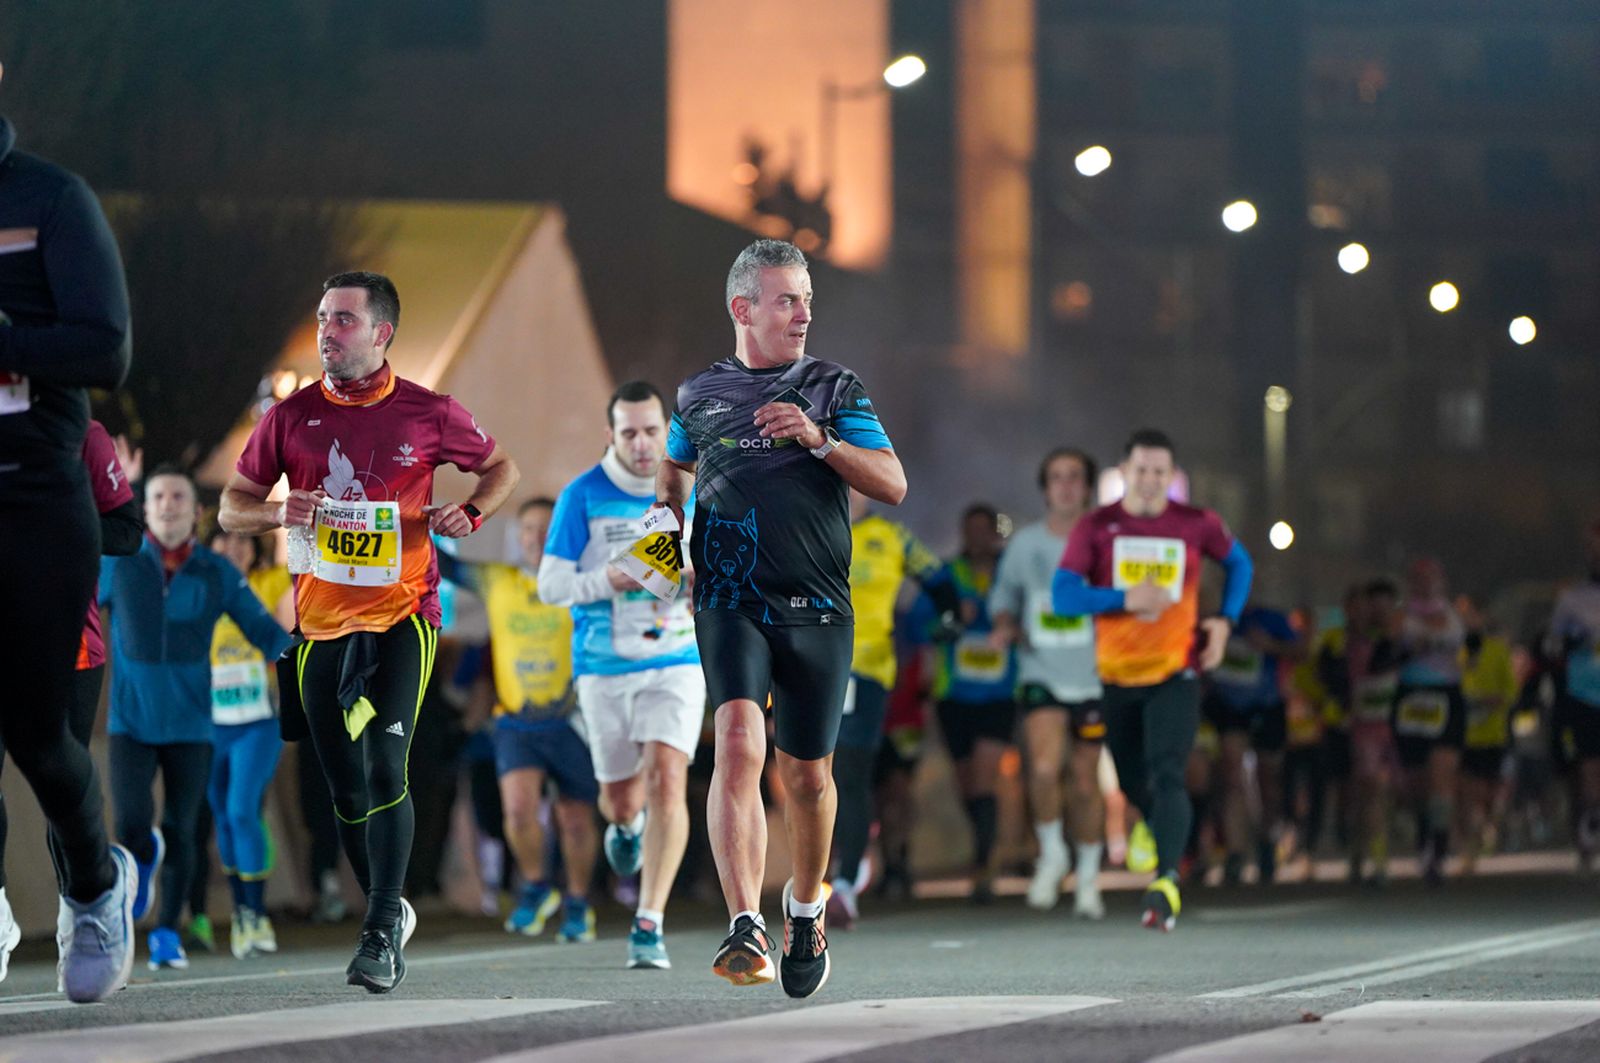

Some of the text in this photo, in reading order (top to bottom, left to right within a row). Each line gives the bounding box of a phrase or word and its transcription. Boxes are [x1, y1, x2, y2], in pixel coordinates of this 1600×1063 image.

[740, 438, 772, 449] OCR
[329, 510, 367, 519] NOCHE DE
[322, 517, 336, 526] SAN
[327, 530, 383, 557] 4627
